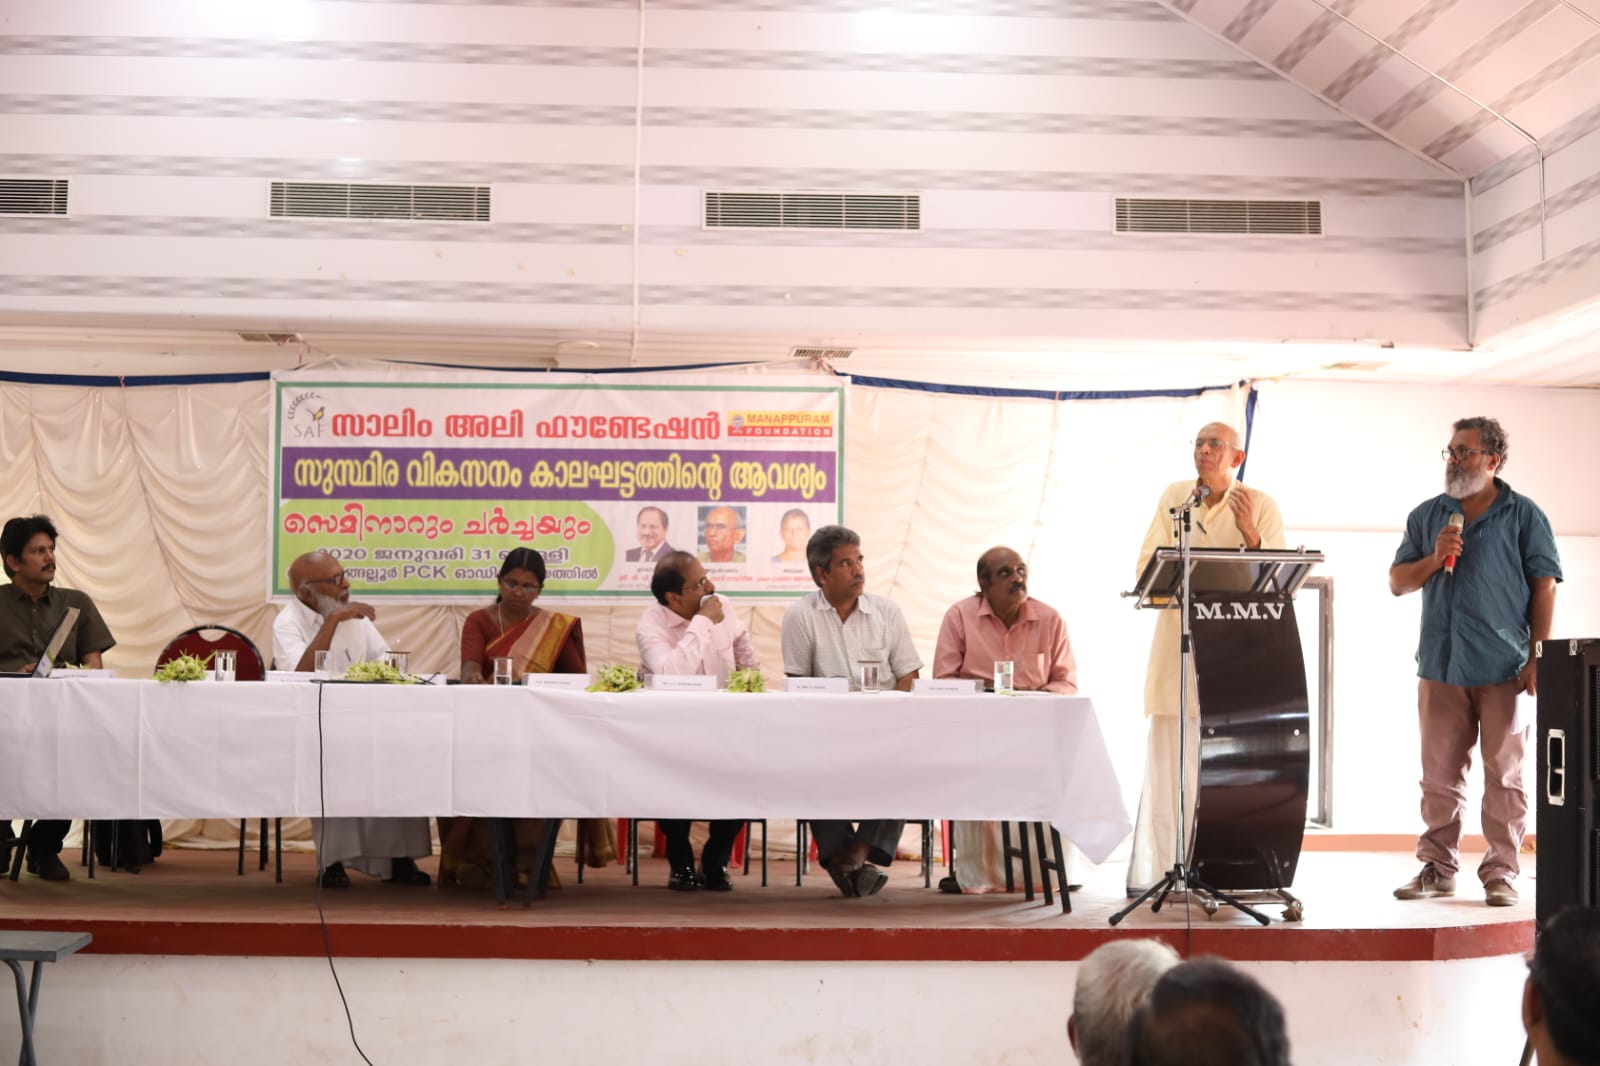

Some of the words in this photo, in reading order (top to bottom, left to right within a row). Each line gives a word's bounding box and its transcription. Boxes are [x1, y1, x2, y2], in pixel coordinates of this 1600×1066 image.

[332, 408, 433, 437] സാലിം
[445, 410, 524, 438] അലി
[747, 414, 830, 424] MANAPPURAM
[746, 427, 831, 436] FOUNDATION
[294, 450, 399, 495] സുസ്ഥിര
[406, 451, 522, 487] വികസനം
[730, 460, 827, 499] ആവശ്യം
[284, 502, 454, 542] സെമിനാറും
[463, 507, 591, 541] ചർച്ചയും
[375, 547, 464, 562] ജനുവരി
[471, 549, 490, 560] 31
[402, 565, 448, 579] PCK
[1193, 602, 1285, 620] M.M.V
